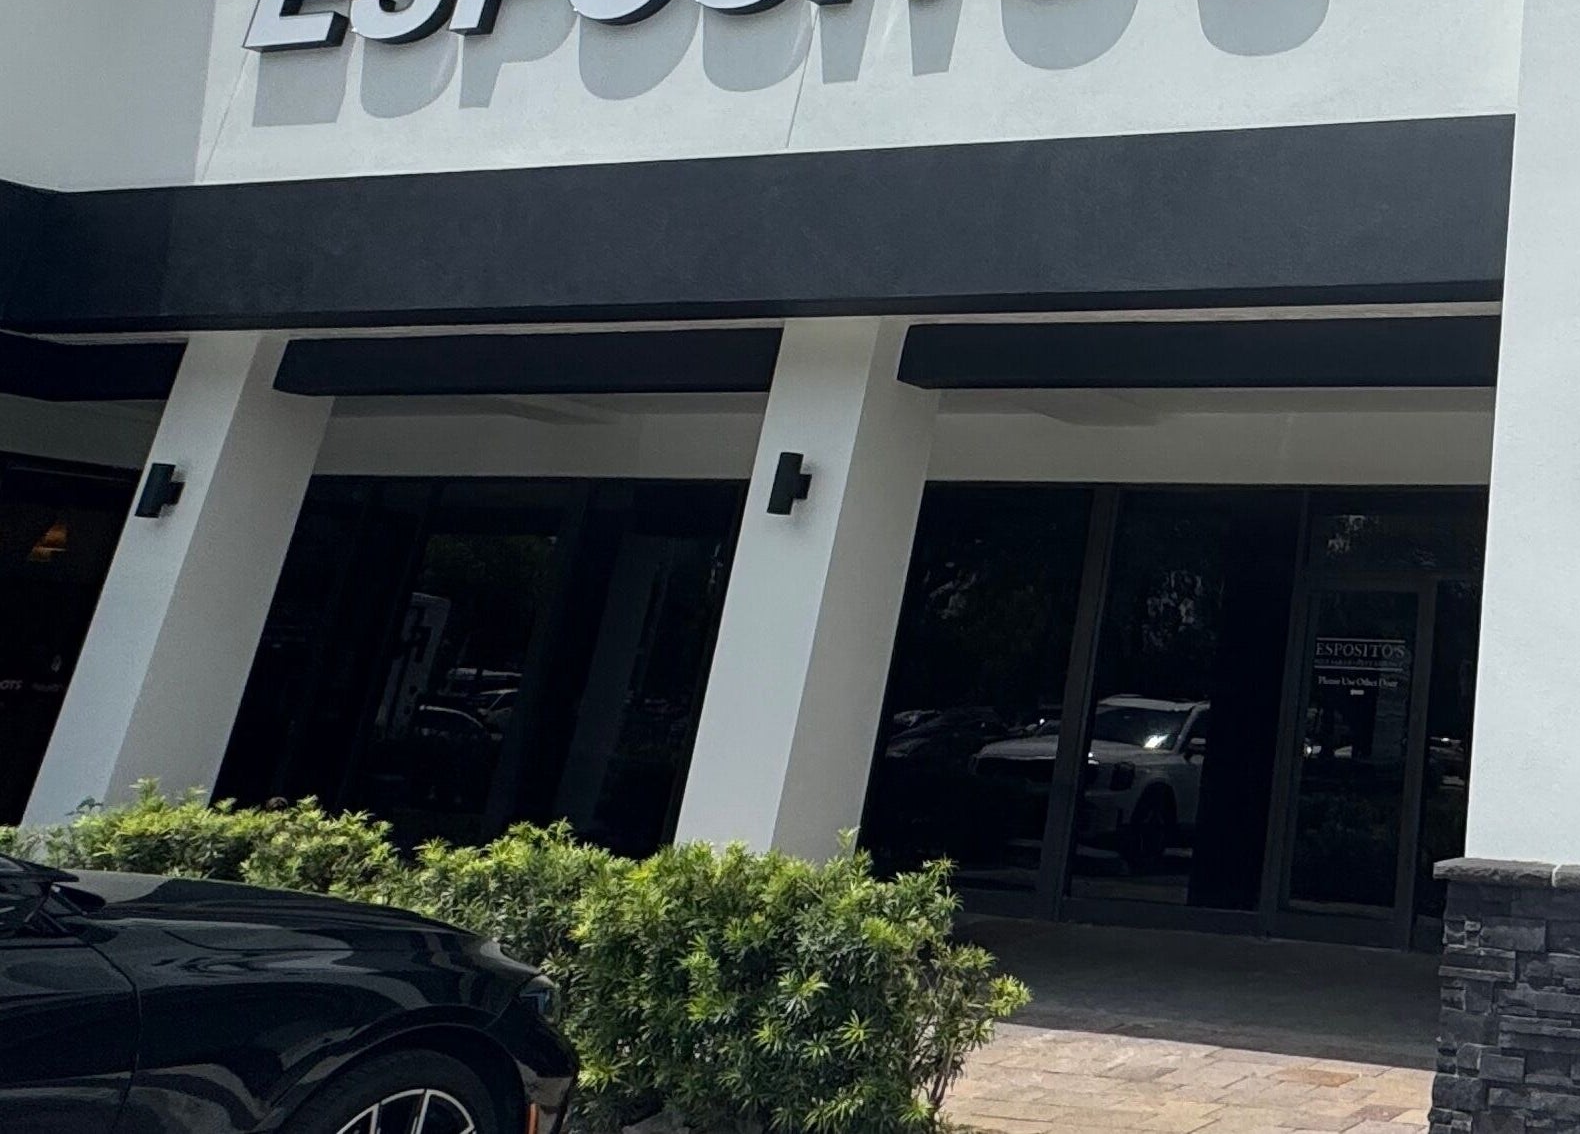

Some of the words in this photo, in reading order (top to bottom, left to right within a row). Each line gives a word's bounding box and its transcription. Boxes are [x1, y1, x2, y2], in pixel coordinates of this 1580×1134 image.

[1315, 642, 1406, 658] ESPOSITO'S
[1341, 676, 1355, 686] Use
[1356, 677, 1377, 687] Other
